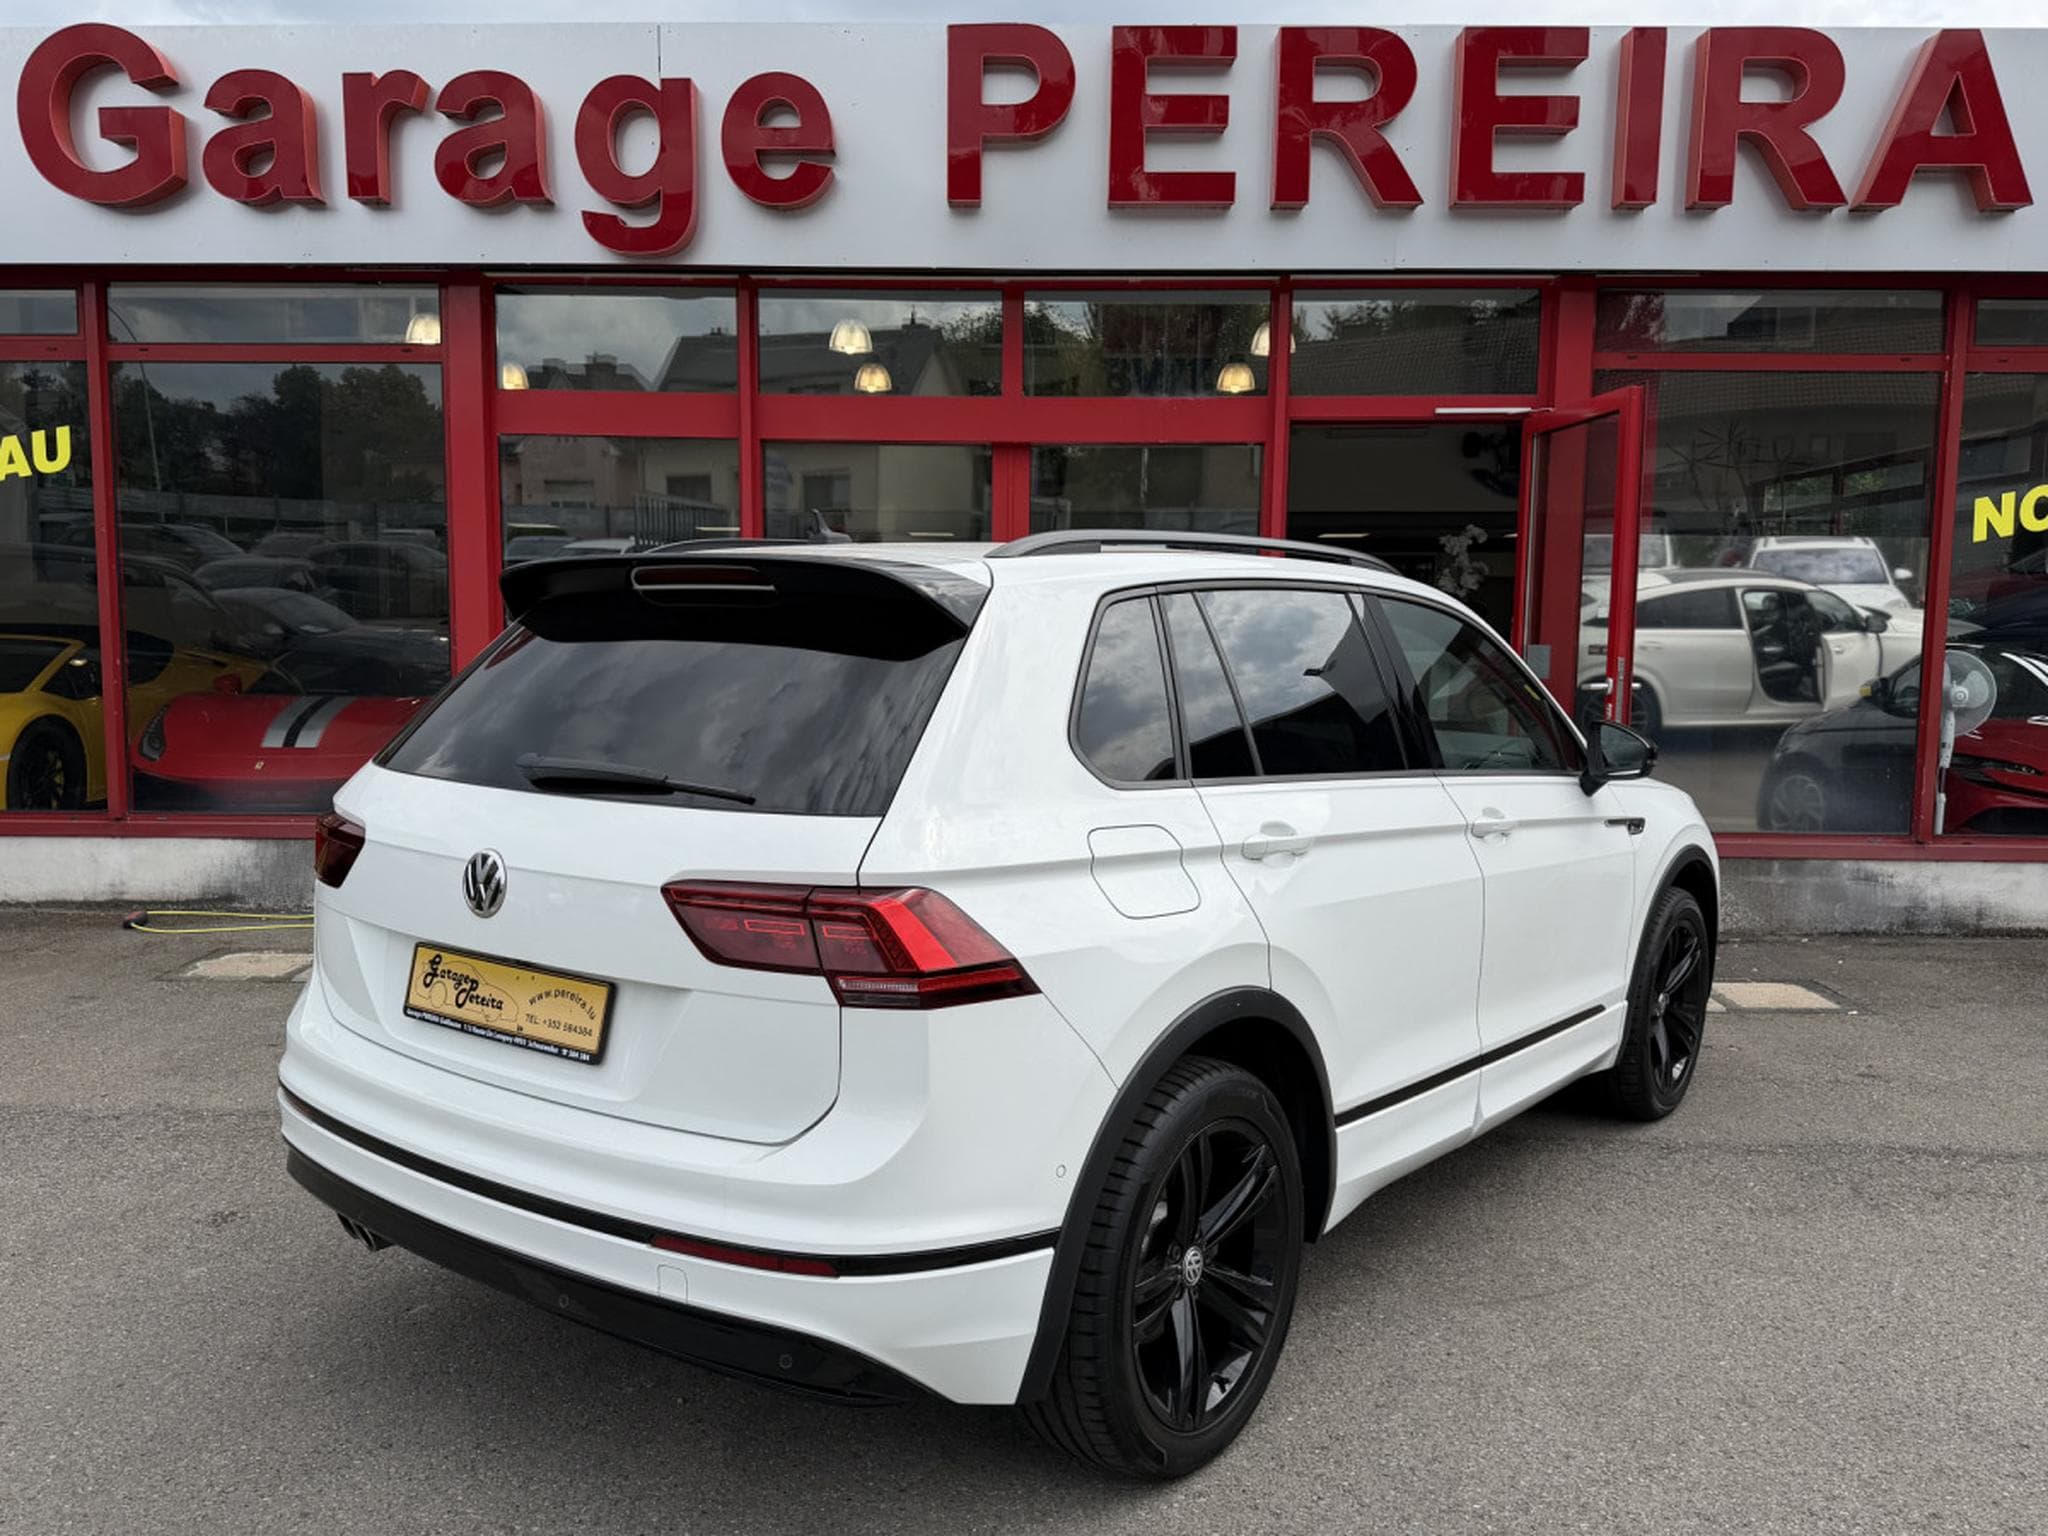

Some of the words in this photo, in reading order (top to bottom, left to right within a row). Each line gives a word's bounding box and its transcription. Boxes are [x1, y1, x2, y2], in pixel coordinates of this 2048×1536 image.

[16, 23, 837, 257] Garage
[946, 23, 2034, 212] PEREIRA
[423, 954, 471, 990] Garage
[455, 978, 504, 1010] Pereira
[528, 988, 597, 1021] www.pereira.lu
